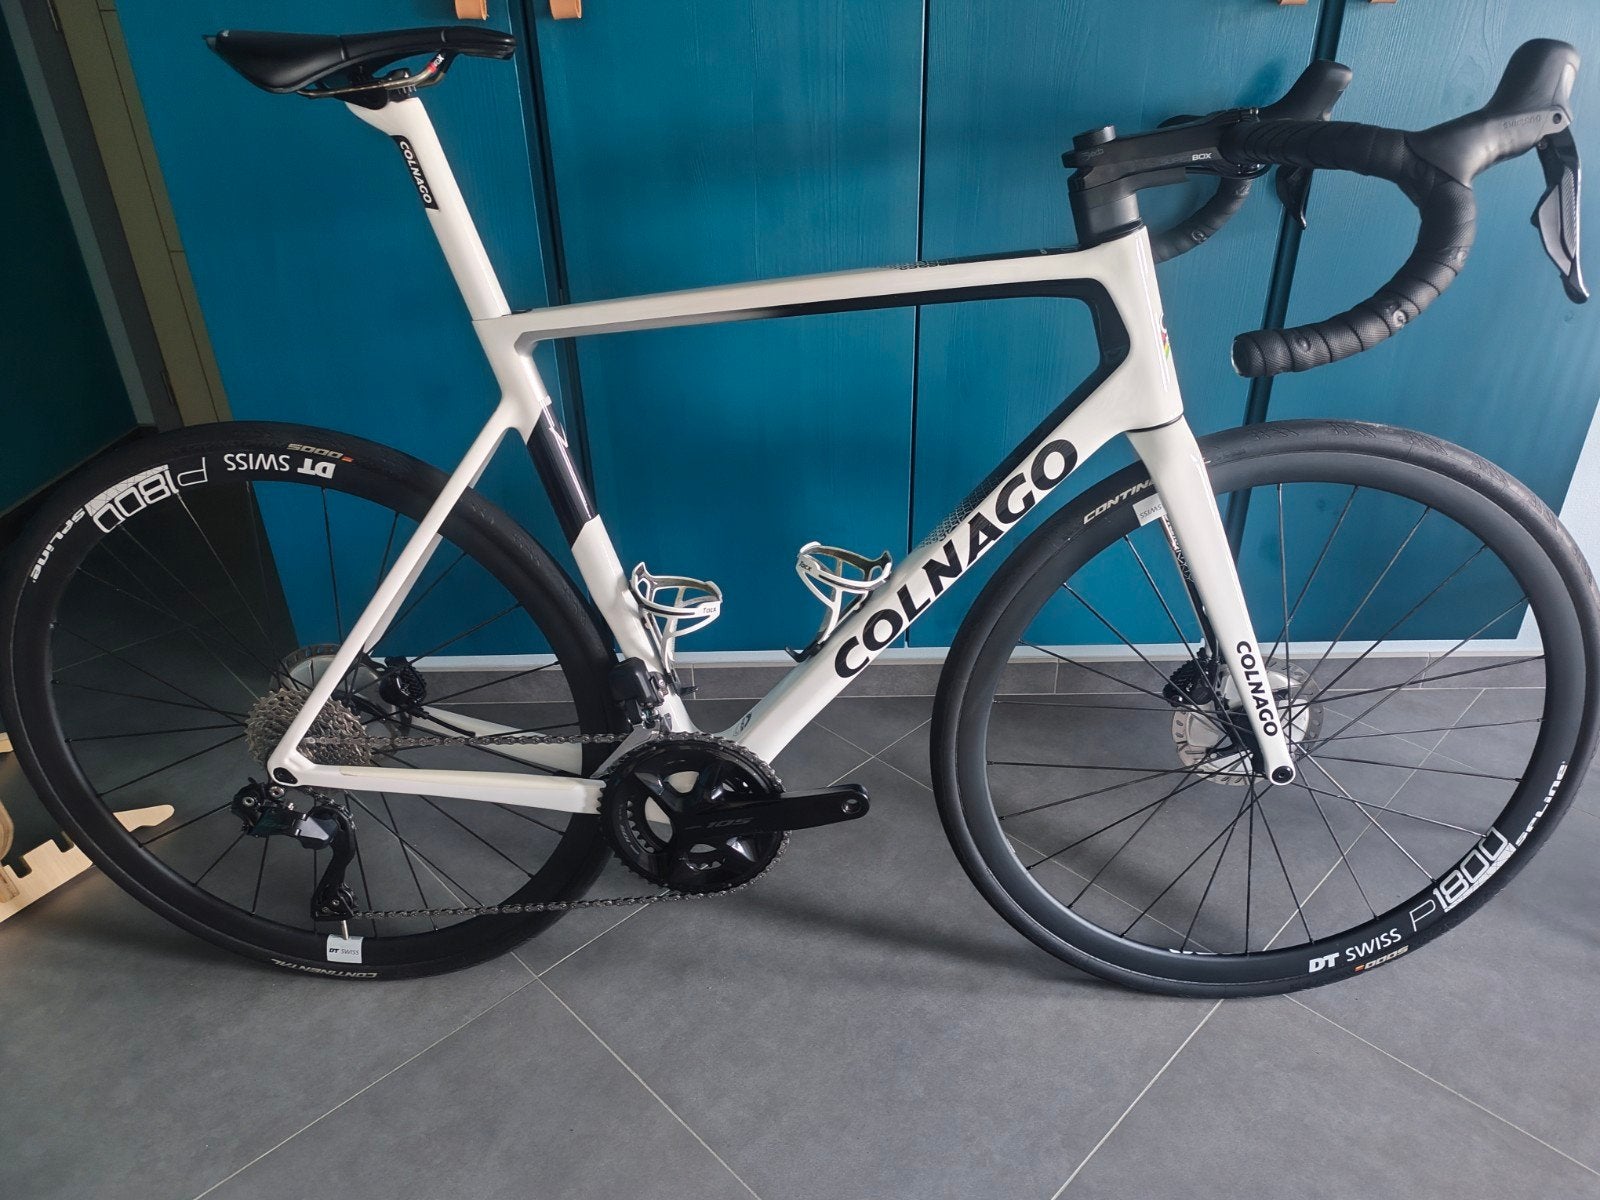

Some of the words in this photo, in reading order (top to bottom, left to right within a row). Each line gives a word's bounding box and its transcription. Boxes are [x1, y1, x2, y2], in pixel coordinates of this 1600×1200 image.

[399, 140, 433, 204] COLNAGO
[223, 452, 290, 472] SWISS
[286, 443, 344, 459] 5000
[297, 457, 336, 479] DT
[92, 456, 208, 533] P1800
[834, 438, 1079, 679] COLNAGO
[1236, 640, 1278, 737] COLNAGO
[1409, 826, 1509, 932] P1800
[270, 957, 378, 978] CONTINENTAL
[341, 947, 360, 956] SWISS
[1308, 951, 1340, 973] DT
[1345, 927, 1402, 963] SWISS
[1363, 944, 1409, 970] 5000
